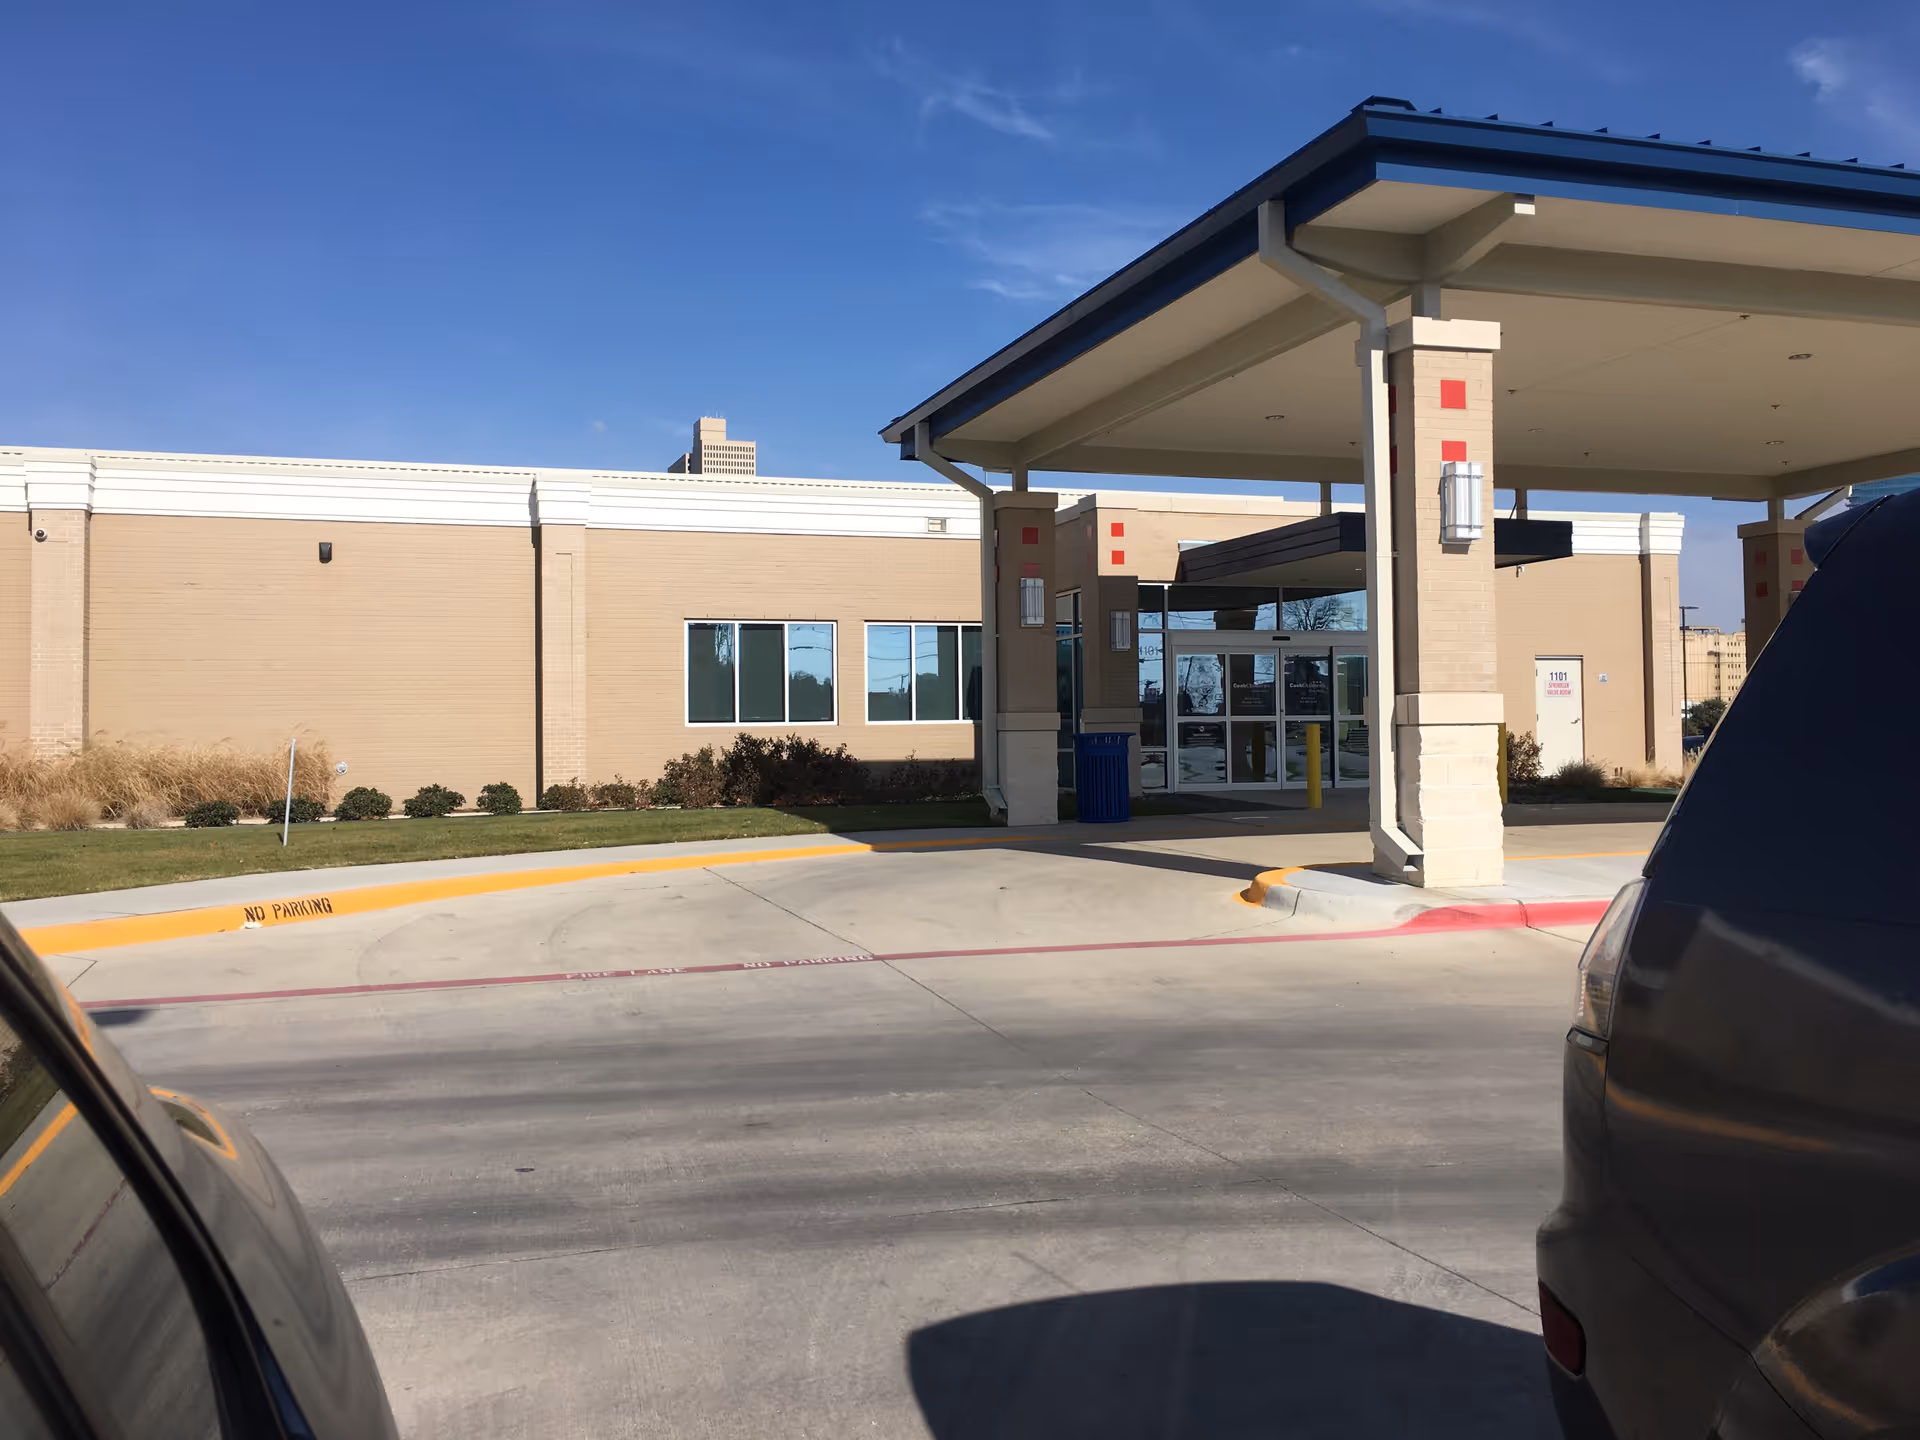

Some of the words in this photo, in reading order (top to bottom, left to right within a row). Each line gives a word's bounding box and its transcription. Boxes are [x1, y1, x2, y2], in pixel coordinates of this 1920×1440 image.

[1549, 671, 1568, 681] 1101
[243, 906, 266, 922] NO
[272, 897, 333, 920] PARKING
[743, 961, 772, 969] NO
[783, 954, 874, 966] PARKING
